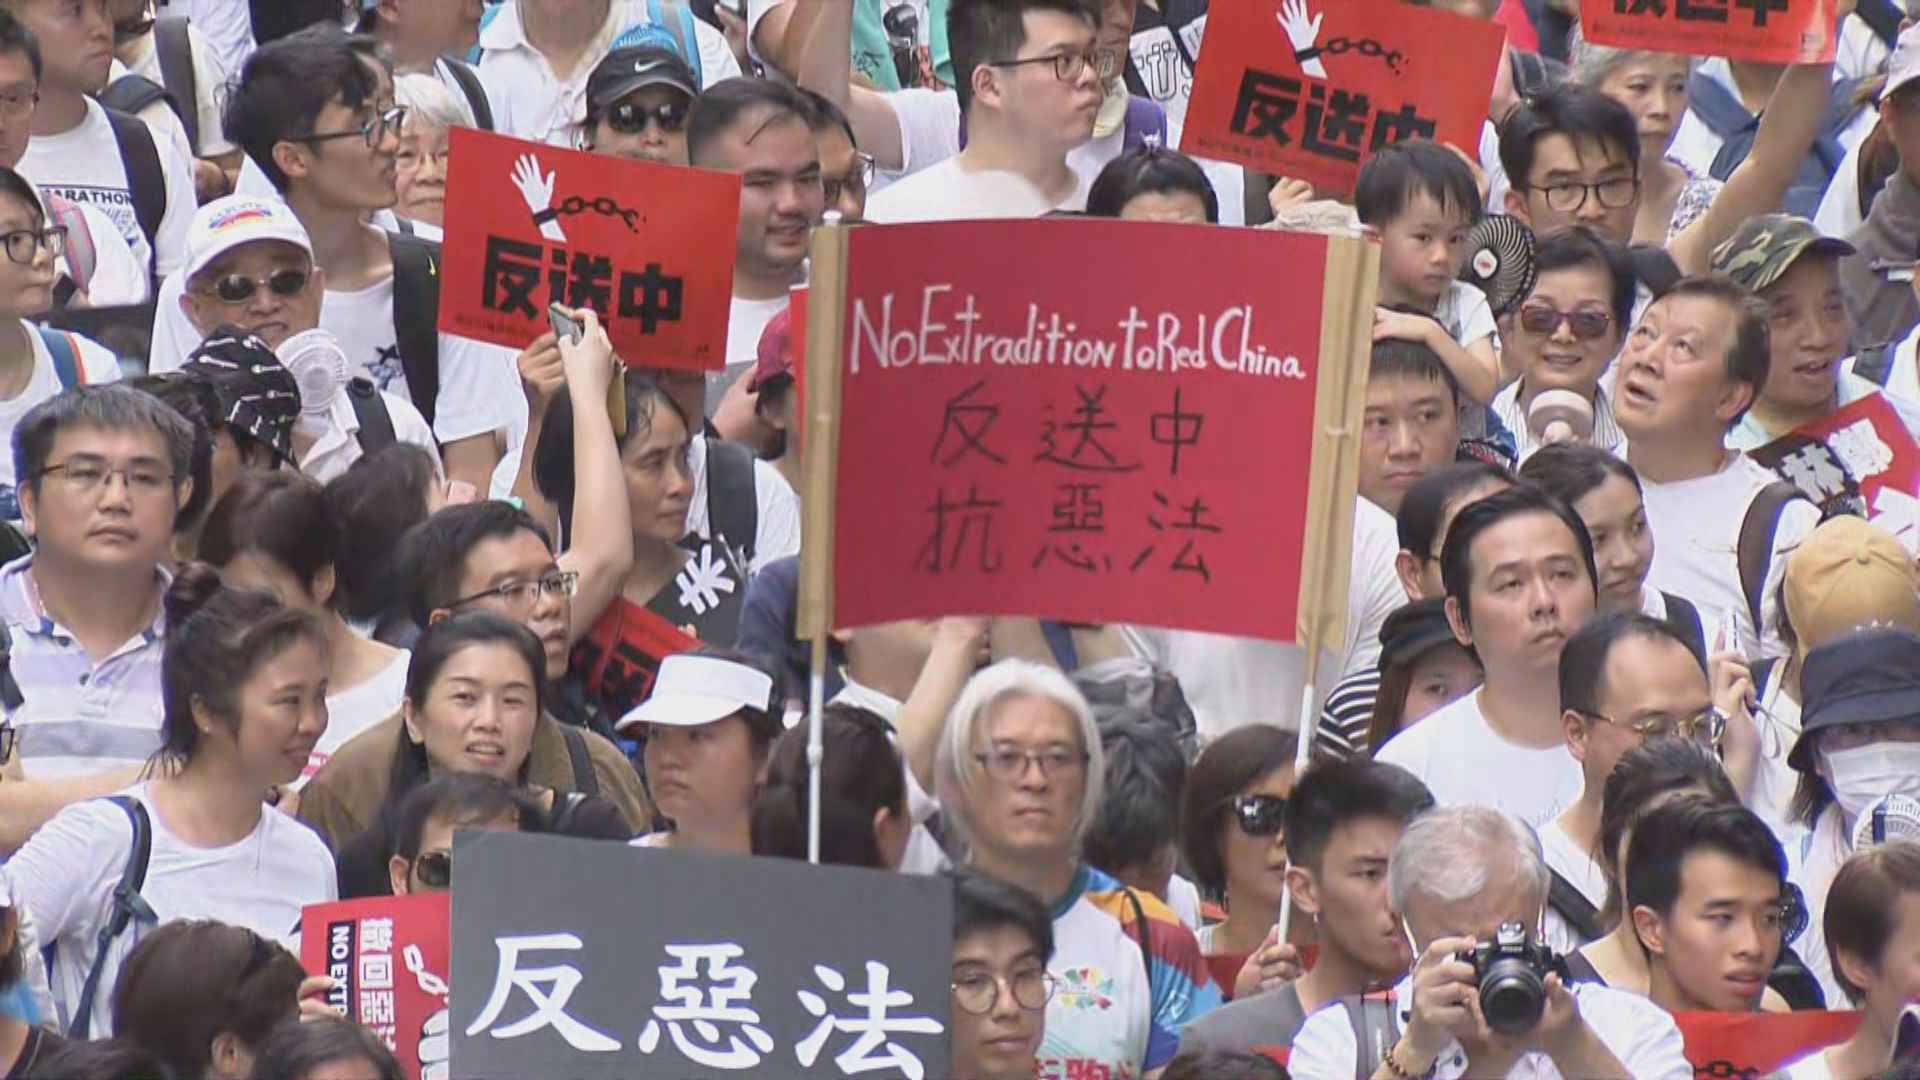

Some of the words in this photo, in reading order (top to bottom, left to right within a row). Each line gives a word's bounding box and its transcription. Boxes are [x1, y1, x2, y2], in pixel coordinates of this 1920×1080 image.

[482, 234, 684, 335] 反送中
[851, 292, 916, 374] No
[1117, 306, 1157, 370] to
[1155, 312, 1207, 372] Red
[1211, 304, 1307, 379] China
[928, 380, 1204, 476] 反送中
[911, 482, 1223, 582] 抗惡法
[330, 925, 351, 960] NO
[464, 932, 945, 1080] 反惡法
